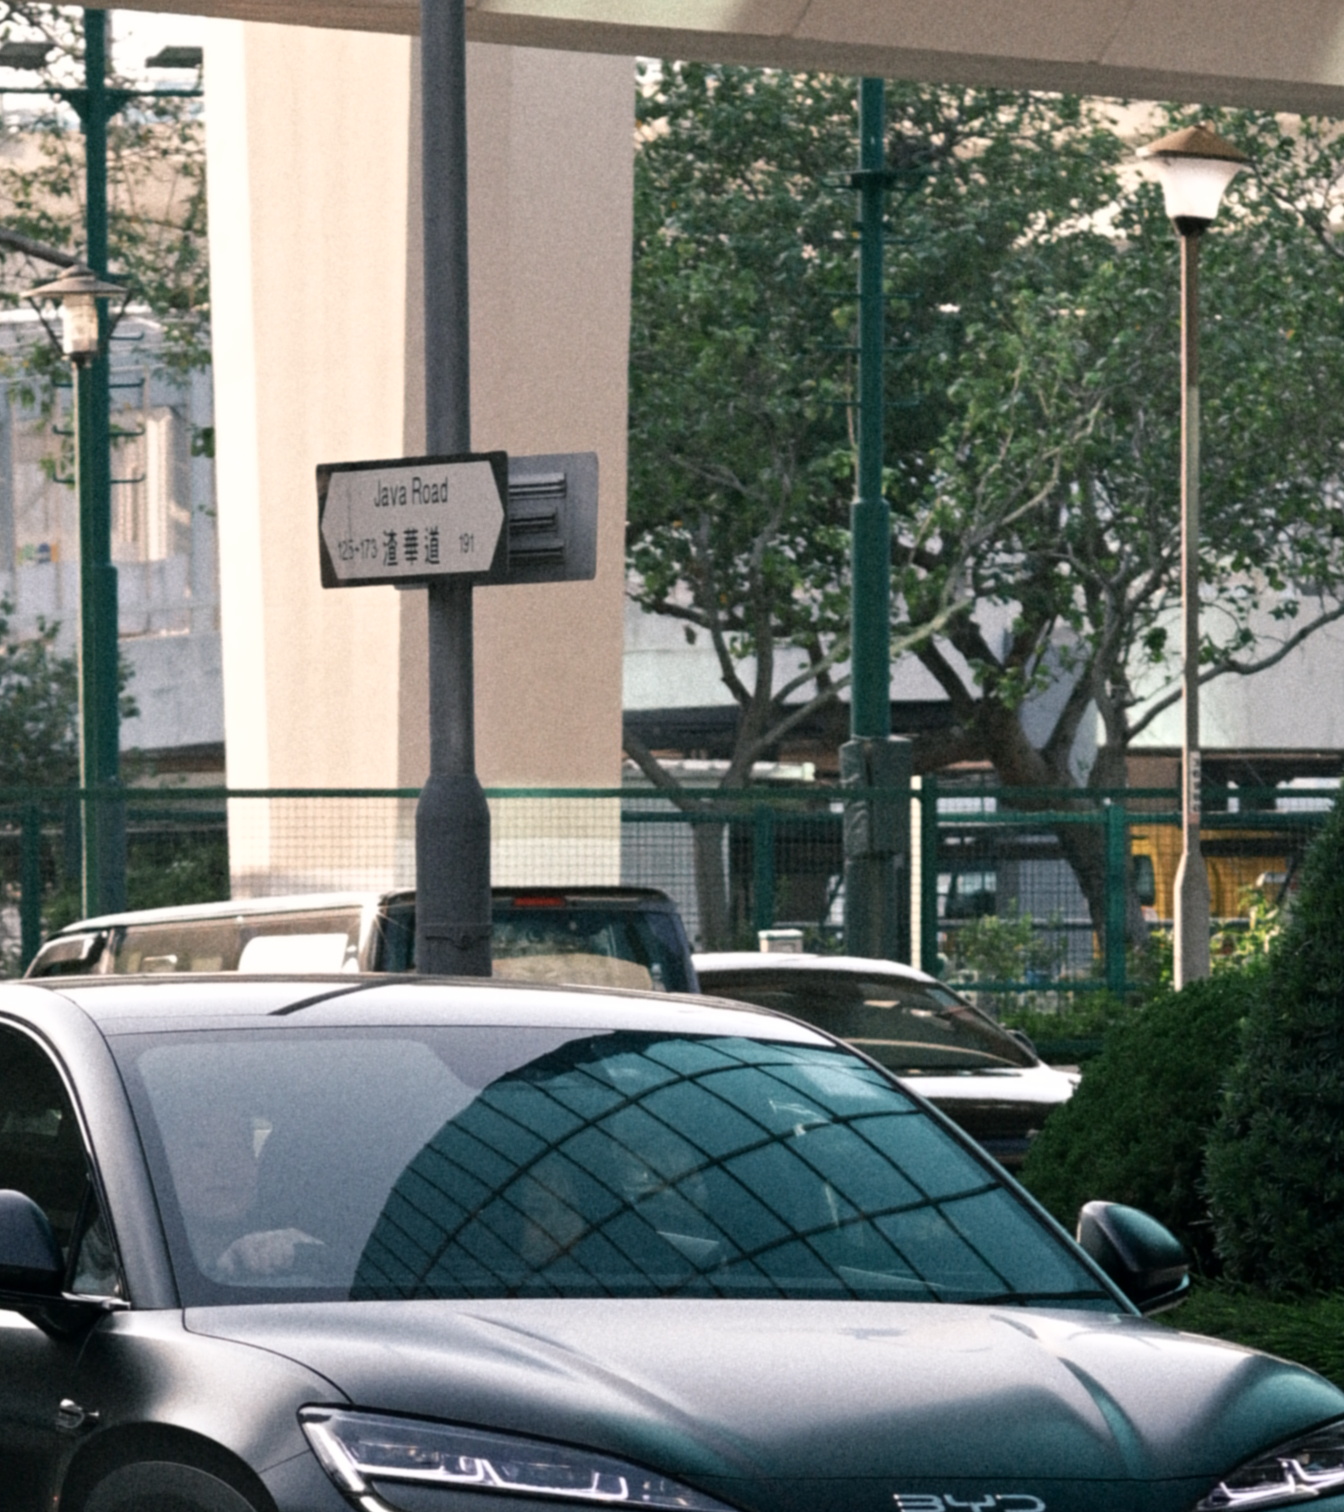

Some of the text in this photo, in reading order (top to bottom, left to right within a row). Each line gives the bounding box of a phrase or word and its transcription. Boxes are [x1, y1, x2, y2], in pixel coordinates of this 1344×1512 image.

[373, 476, 449, 508] Java Road
[383, 525, 440, 566] 渣華道
[459, 532, 475, 554] 191
